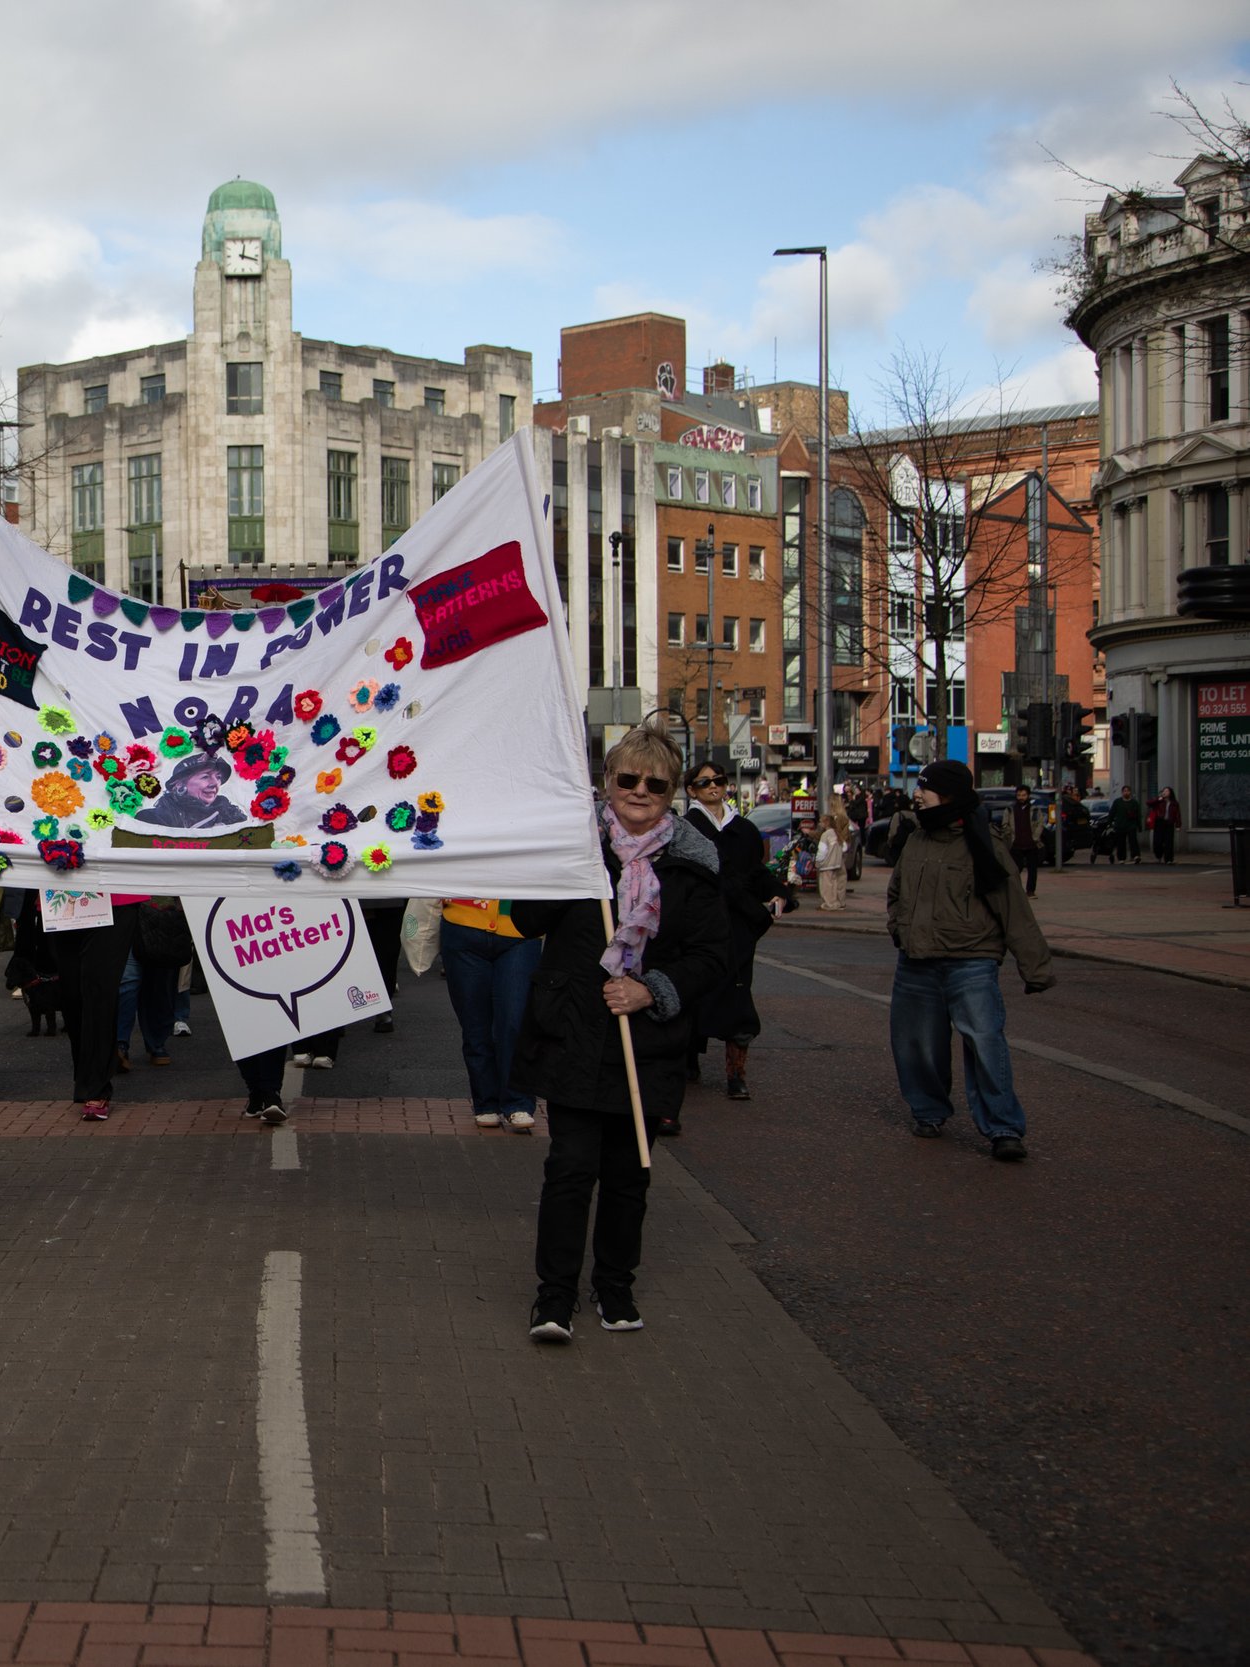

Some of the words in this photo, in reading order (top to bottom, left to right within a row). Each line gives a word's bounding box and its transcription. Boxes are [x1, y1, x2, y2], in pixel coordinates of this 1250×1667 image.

[417, 570, 475, 609] MAKE
[421, 569, 522, 629] PATTERNS
[19, 586, 152, 671] REST
[178, 642, 239, 682] IN
[260, 553, 410, 671] POWER
[425, 628, 473, 658] WAR
[11, 666, 33, 689] BE
[1199, 687, 1218, 703] TO
[1222, 685, 1247, 702] LET
[119, 683, 294, 740] NORA
[1199, 705, 1211, 715] 90
[1212, 704, 1228, 714] 324
[1230, 703, 1247, 714] 555
[1200, 722, 1227, 733] PRIME
[980, 737, 1002, 750] extern
[1200, 735, 1229, 746] RETAIL
[733, 749, 748, 757] ENDS
[795, 800, 818, 811] PERFE
[225, 905, 295, 942] Ma's
[233, 913, 344, 968] Matter!
